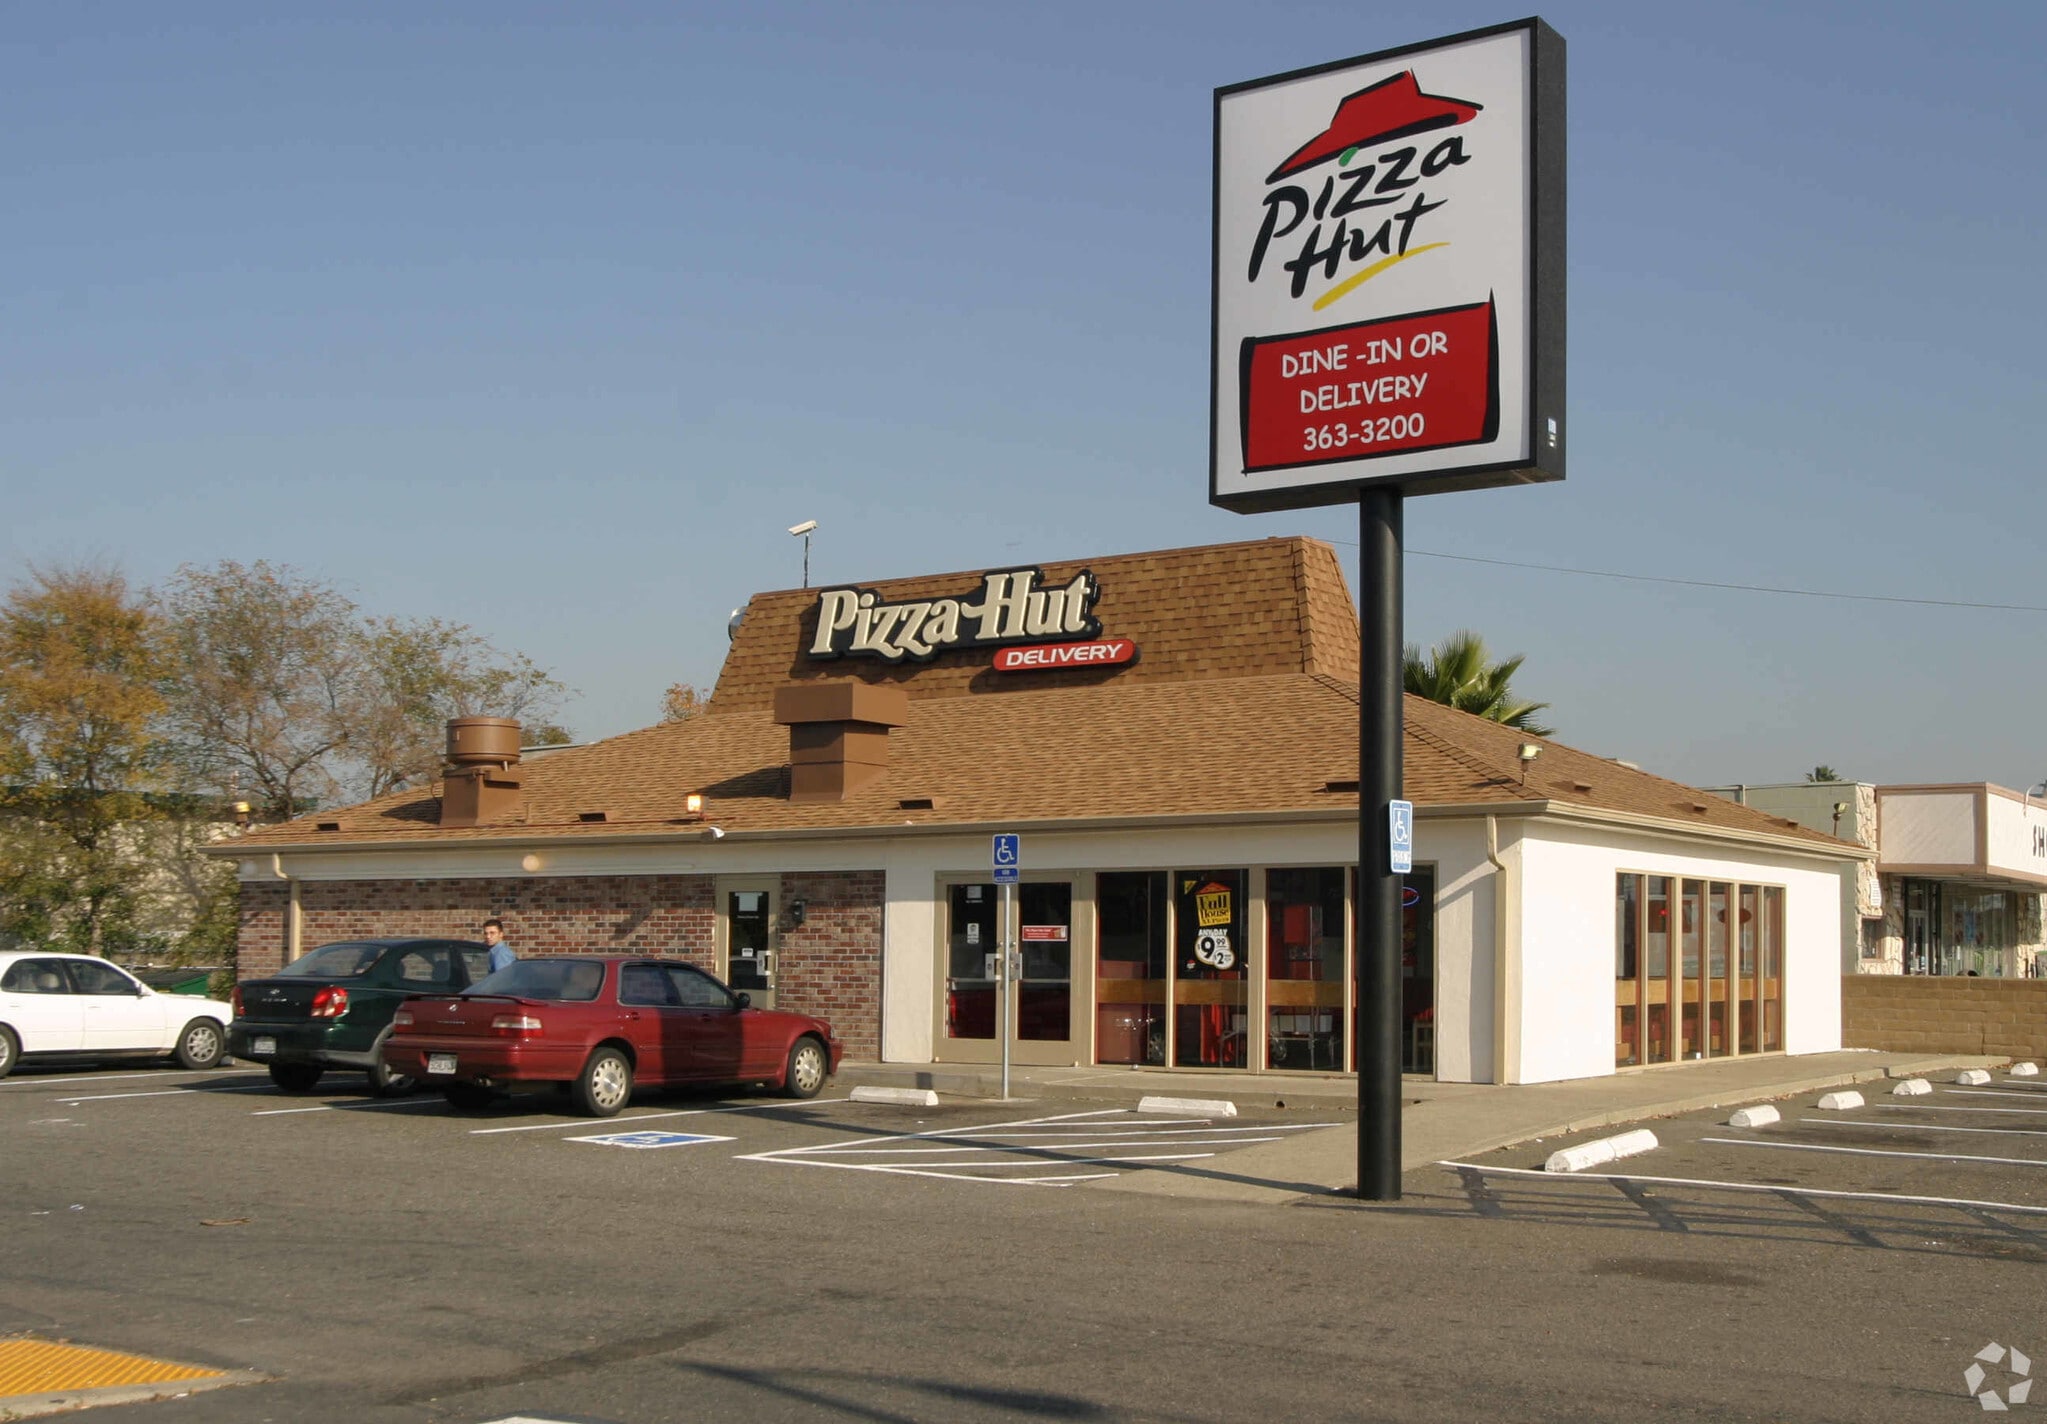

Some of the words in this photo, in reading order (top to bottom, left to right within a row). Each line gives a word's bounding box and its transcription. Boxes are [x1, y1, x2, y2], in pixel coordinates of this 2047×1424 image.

[1248, 136, 1471, 282] Pizza
[1284, 192, 1449, 299] Hut
[1282, 344, 1348, 378] DINE
[1356, 337, 1402, 365] -IN
[1410, 331, 1448, 358] OR
[1300, 372, 1428, 414] DELIVERY
[1303, 412, 1425, 451] 363-3200
[809, 589, 962, 659] Pizza
[961, 570, 1091, 641] Hut
[1005, 643, 1124, 667] DELIVERY
[2032, 824, 2047, 858] SH
[1199, 895, 1227, 909] Full
